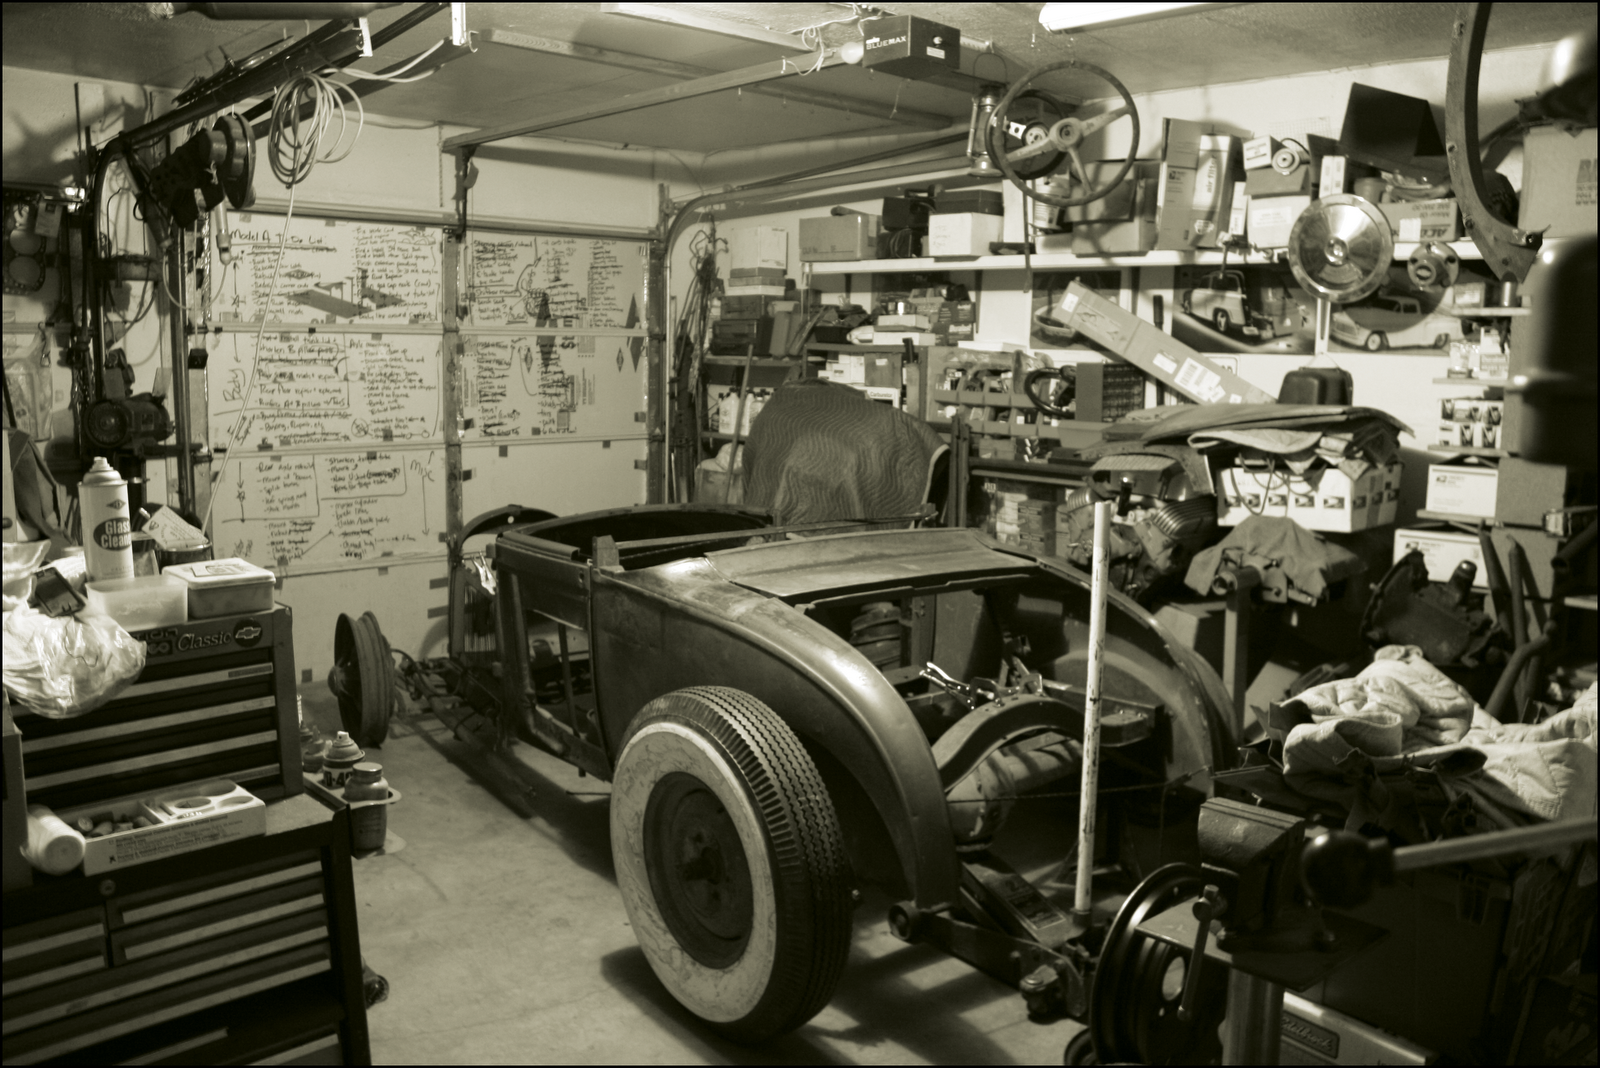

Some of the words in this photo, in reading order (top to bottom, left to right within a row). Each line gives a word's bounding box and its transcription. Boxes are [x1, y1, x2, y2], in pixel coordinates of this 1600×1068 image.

[866, 35, 907, 50] BLUEMAX
[230, 228, 259, 242] Model
[262, 229, 271, 244] A
[104, 520, 131, 536] Glass
[100, 532, 132, 549] Cleane
[178, 631, 232, 651] Classic
